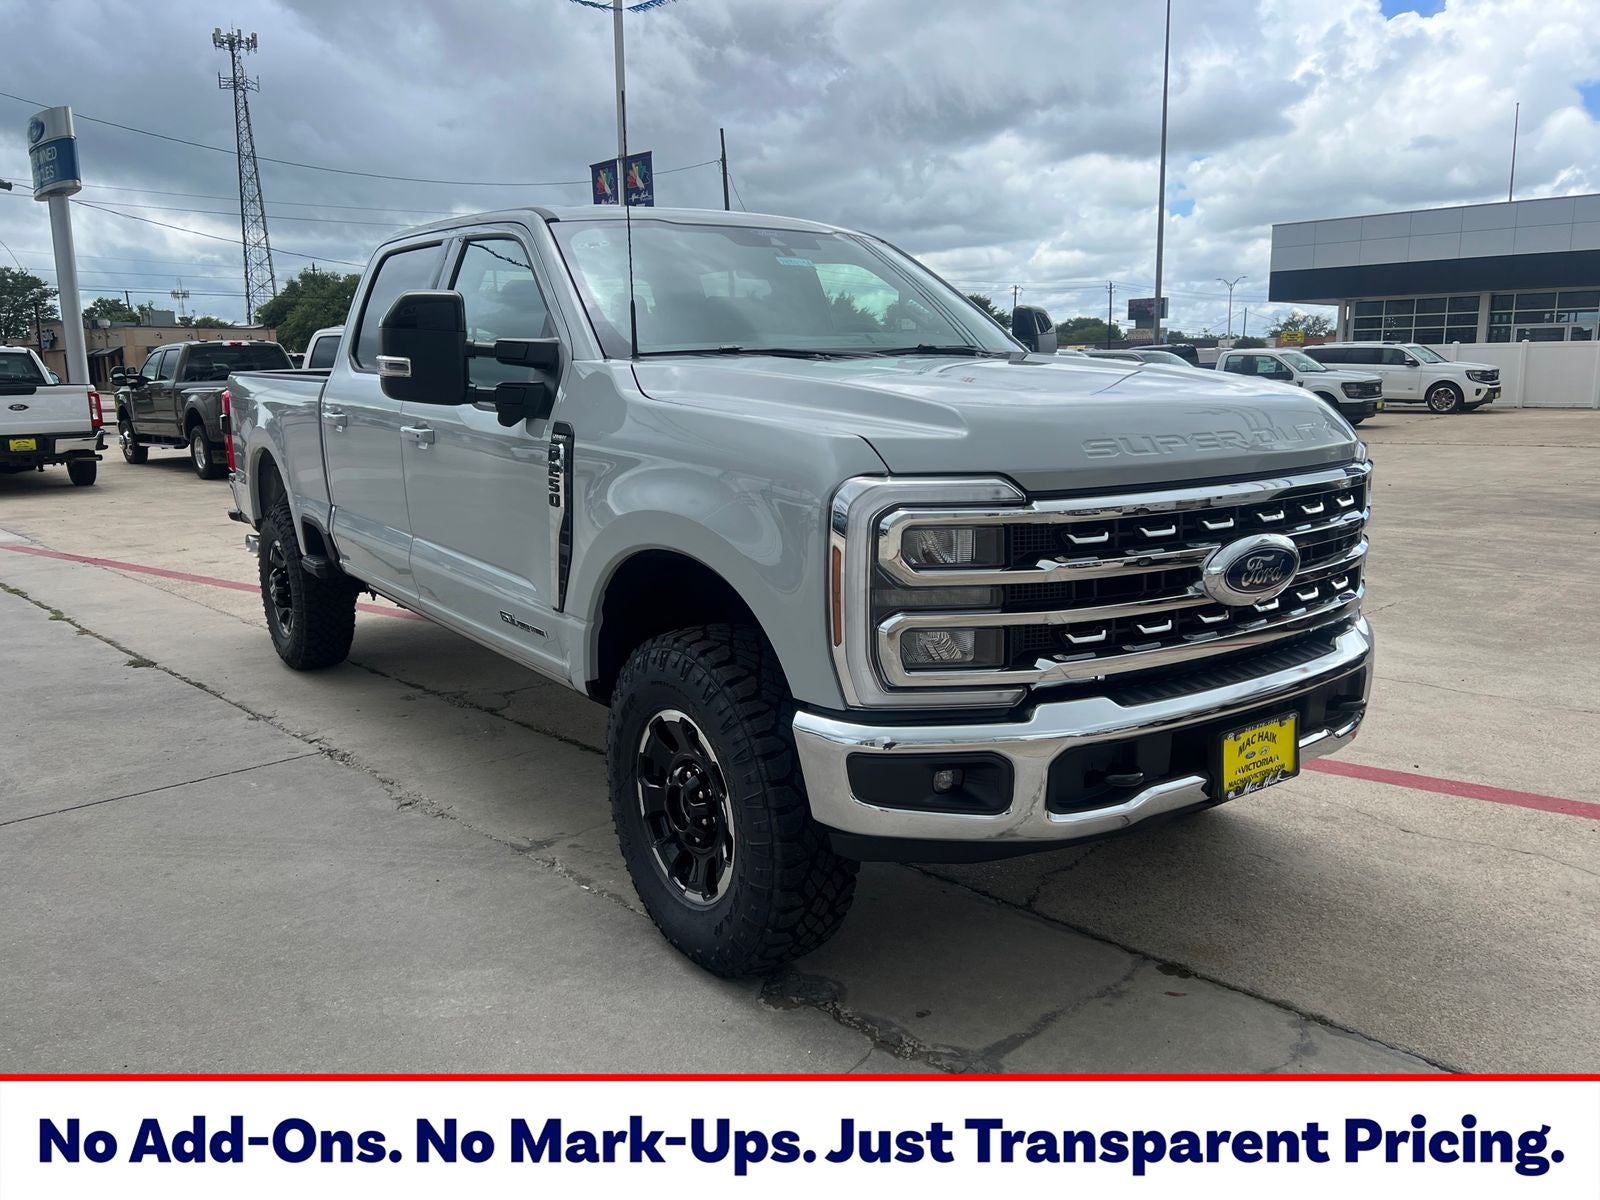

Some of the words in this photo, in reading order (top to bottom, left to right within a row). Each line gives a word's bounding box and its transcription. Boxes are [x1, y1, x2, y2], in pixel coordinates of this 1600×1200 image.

[1081, 430, 1249, 459] SUPER
[1241, 554, 1285, 588] Ford
[1238, 732, 1257, 757] MAC
[1257, 731, 1277, 744] HAIK
[1240, 756, 1274, 774] VICTORIA
[1243, 780, 1261, 795] Mac
[1262, 771, 1283, 788] Haik
